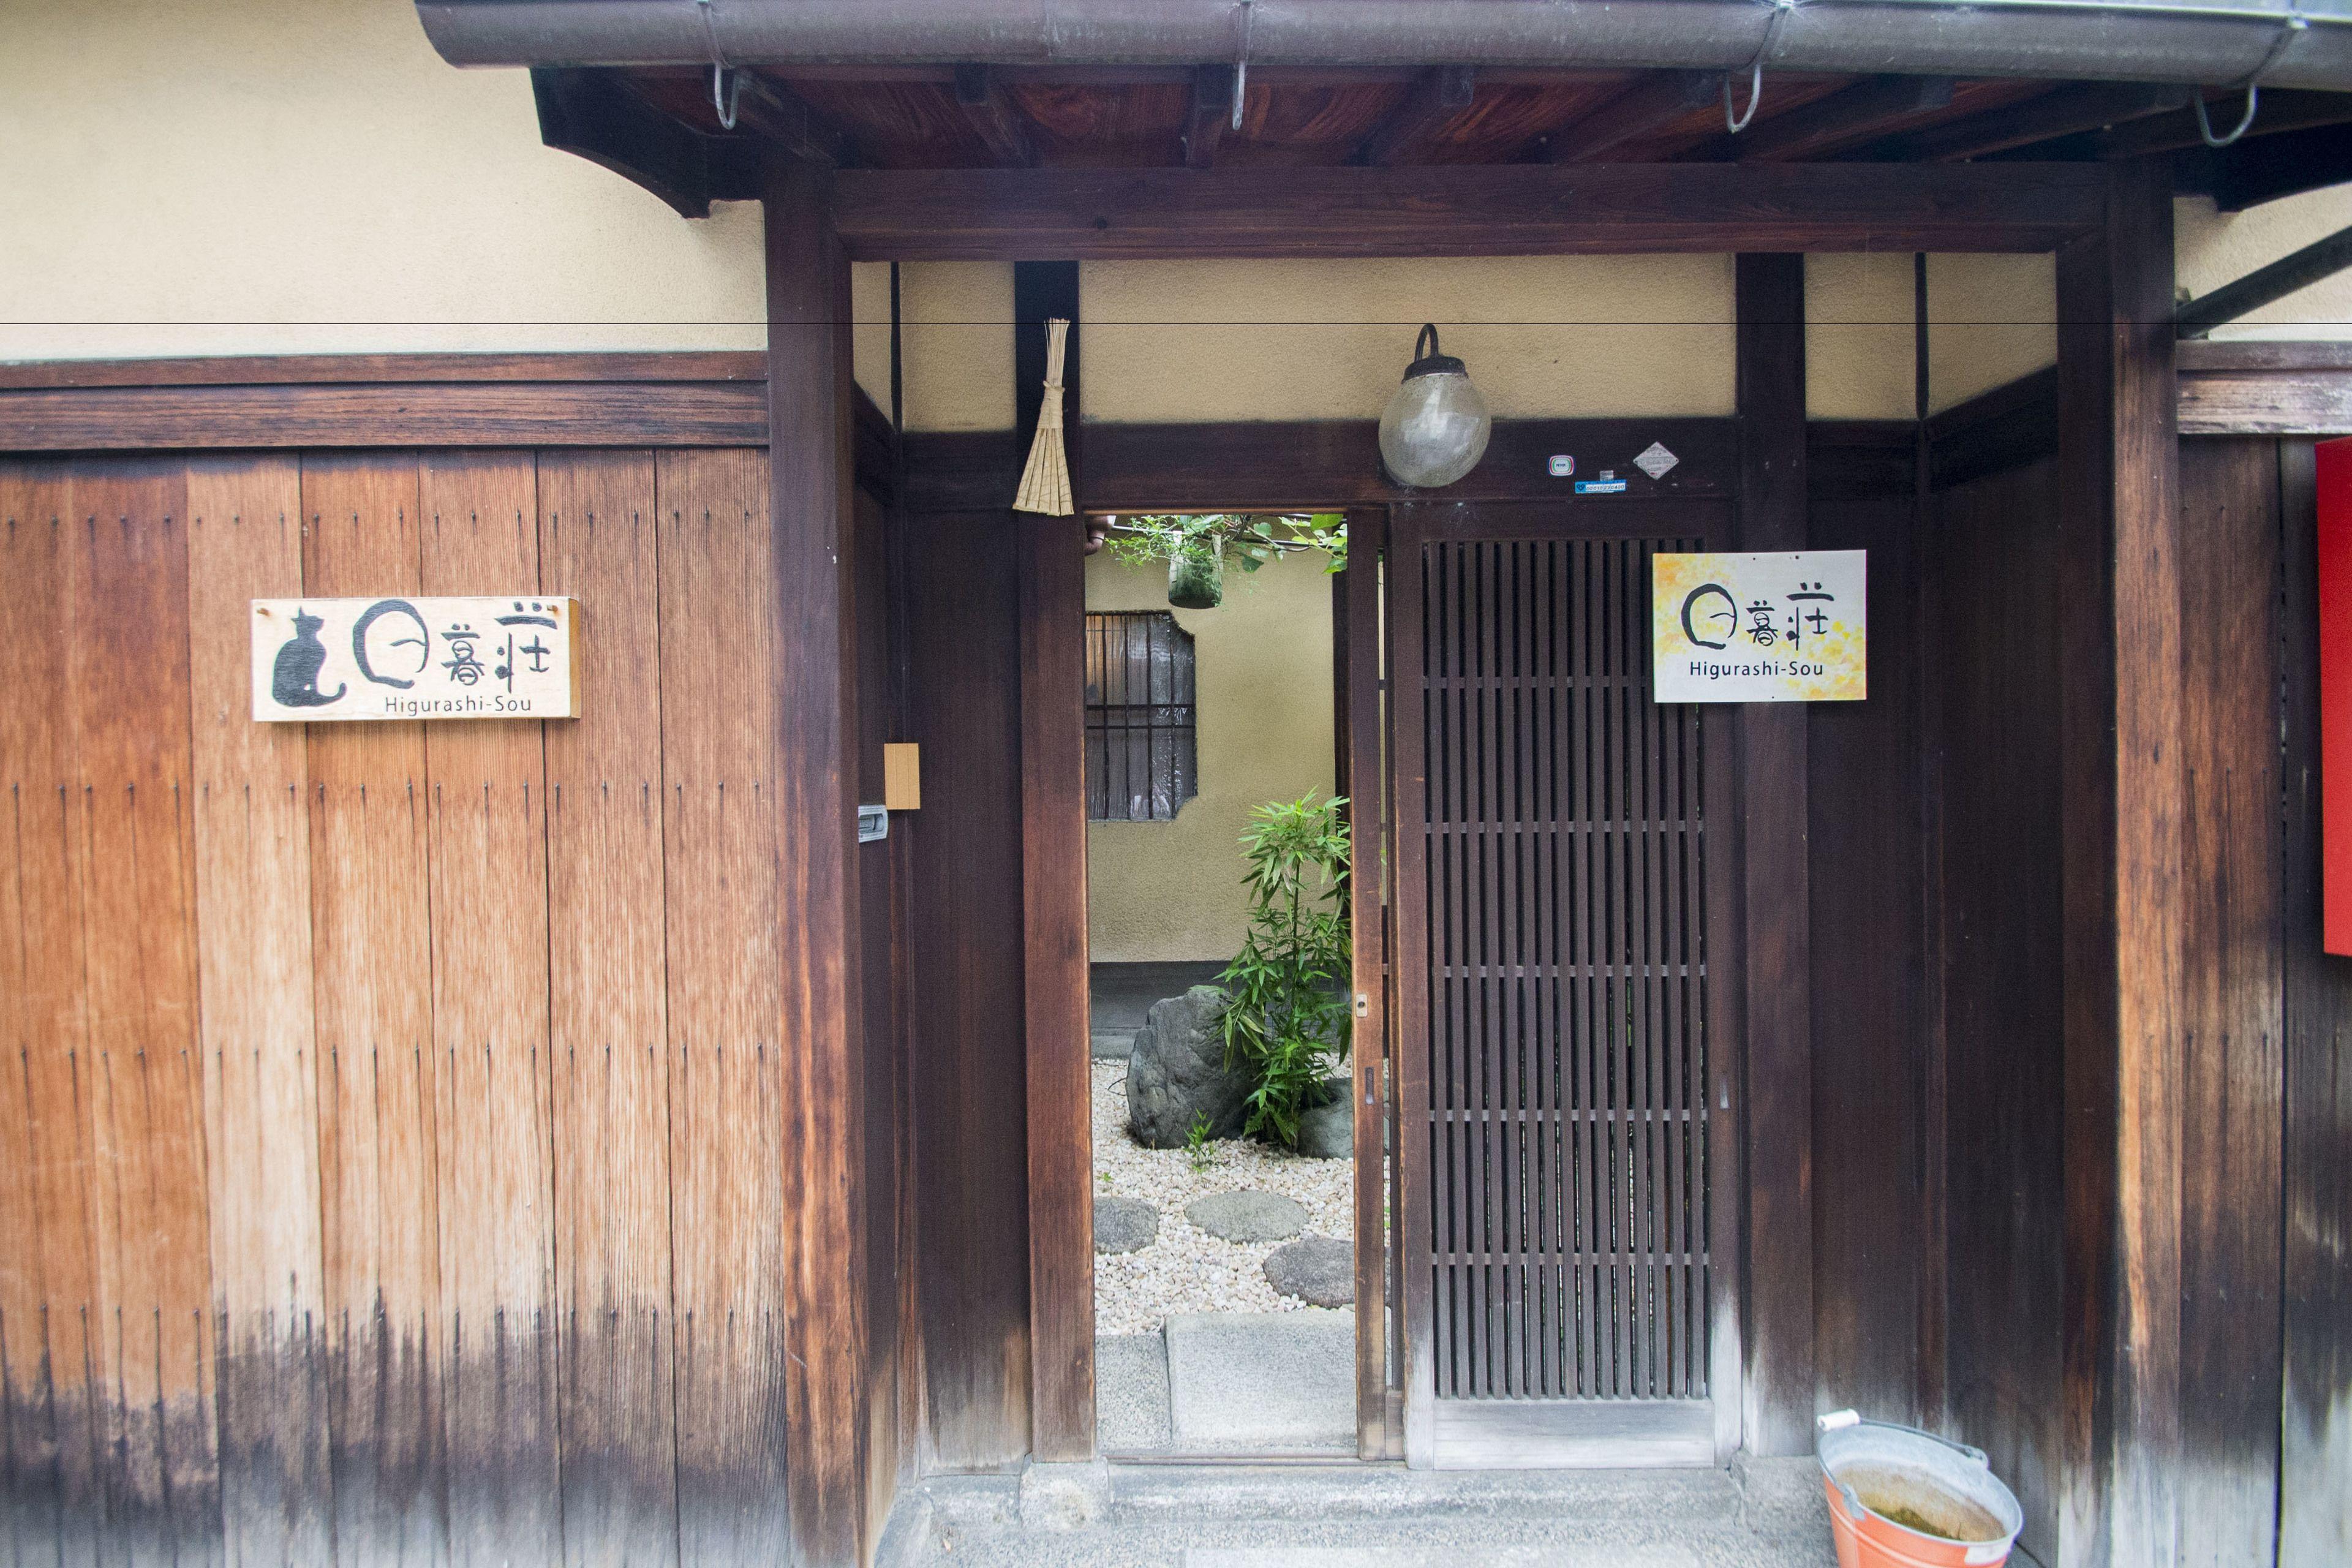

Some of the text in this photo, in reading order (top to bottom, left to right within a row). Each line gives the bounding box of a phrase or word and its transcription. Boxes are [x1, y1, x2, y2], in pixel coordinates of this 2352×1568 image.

[1681, 582, 1834, 651] 日暮荘
[352, 599, 558, 693] 日暮荘
[1689, 661, 1823, 680] Higurashi-Sou
[385, 695, 532, 716] Higurashi-Sou
